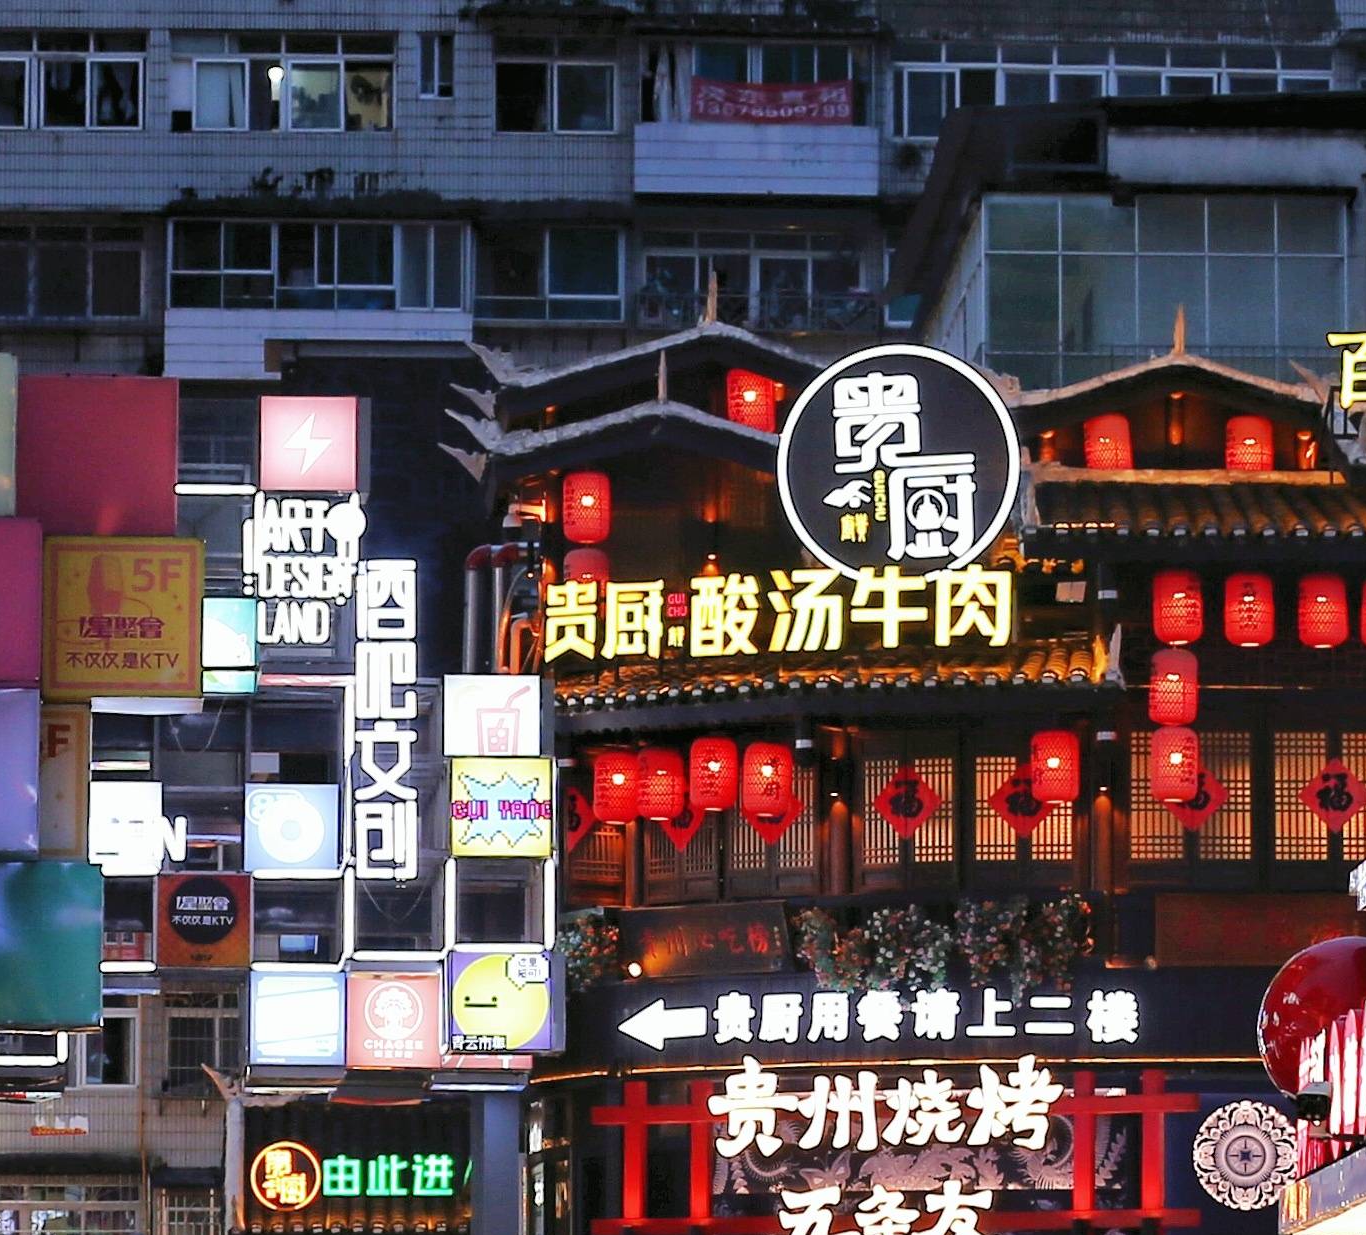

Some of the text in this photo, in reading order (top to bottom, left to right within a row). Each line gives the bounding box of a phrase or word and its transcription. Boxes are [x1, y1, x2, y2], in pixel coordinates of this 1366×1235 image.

[263, 498, 330, 553] ART
[132, 558, 183, 592] 5F
[256, 600, 332, 645] LAND
[544, 564, 1014, 664] 贵厨 酸汤牛肉
[66, 651, 180, 669] 不仅仅是KTV
[40, 724, 71, 758] F
[355, 558, 419, 880] 酒吧文创
[713, 988, 1141, 1044] 贵厨用餐请上二楼
[708, 1054, 1064, 1158] 贵州烧烤
[322, 1154, 454, 1197] 由此进
